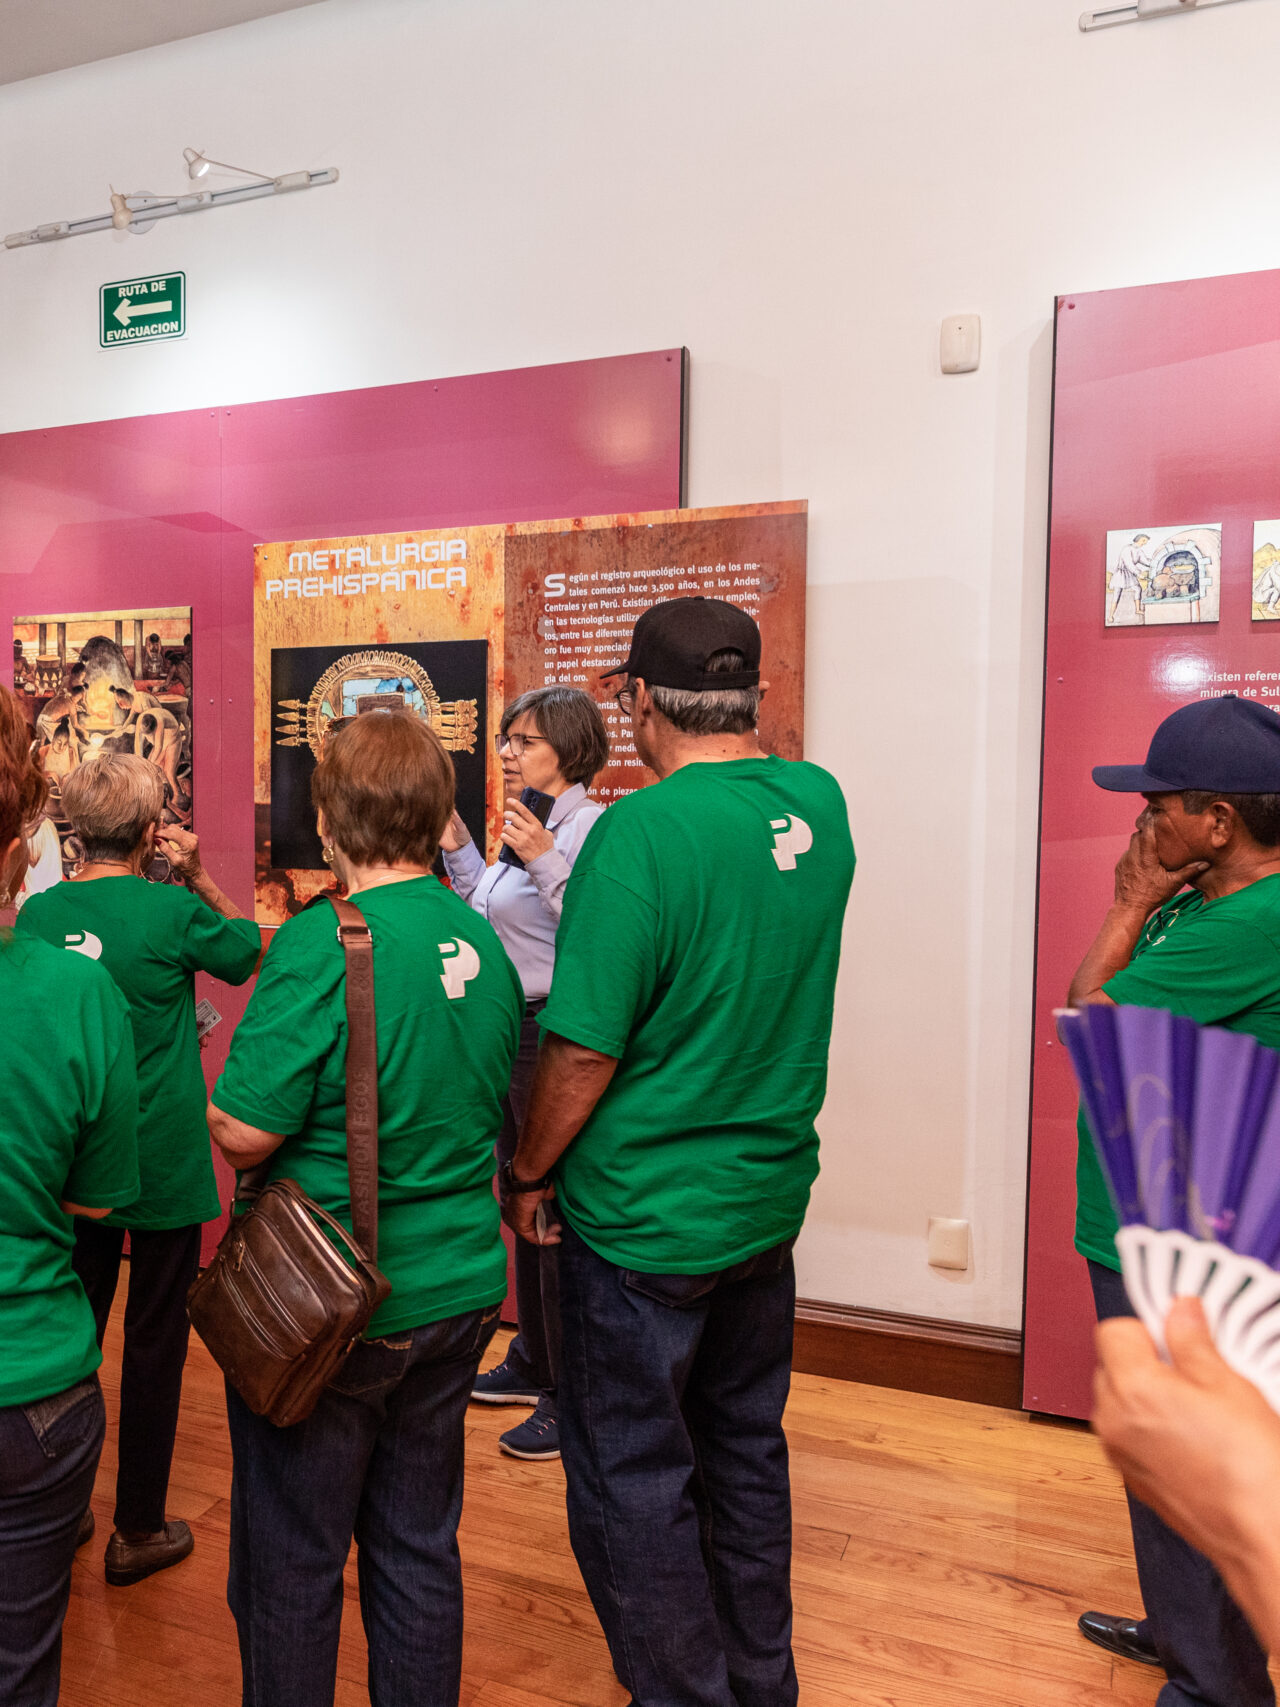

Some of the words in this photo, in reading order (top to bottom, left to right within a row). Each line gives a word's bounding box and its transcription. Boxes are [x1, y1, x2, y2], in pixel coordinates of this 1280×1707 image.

[118, 283, 148, 298] RUTA
[150, 280, 166, 293] DE
[106, 321, 179, 341] EVACUACION
[288, 539, 466, 572] METALURGIA
[591, 571, 598, 581] el
[600, 570, 631, 581] registro
[633, 565, 685, 579] arqueológico
[688, 564, 695, 574] el
[697, 565, 713, 574] uso
[715, 562, 726, 572] de
[728, 562, 741, 572] los
[744, 562, 760, 571] me-
[266, 566, 466, 600] PREHISPÁNICA
[569, 587, 587, 597] tales
[591, 584, 625, 595] comenzó
[629, 584, 648, 593] hace
[678, 580, 700, 590] años,
[704, 580, 714, 588] en
[718, 578, 730, 587] los
[734, 576, 760, 586] Andes
[544, 601, 579, 612] Centrales
[582, 603, 587, 612] y
[589, 602, 598, 610] en
[600, 599, 620, 609] Perú.
[622, 598, 653, 608] Existían
[726, 592, 760, 603] empleo,
[544, 619, 553, 627] en
[556, 617, 567, 625] las
[570, 614, 614, 625] tecnologías
[616, 613, 640, 622] utiliza
[544, 632, 558, 641] tos,
[561, 631, 580, 640] entre
[582, 630, 593, 638] las
[595, 628, 634, 638] diferentes
[544, 647, 557, 655] oro
[559, 645, 572, 654] fue
[575, 645, 591, 655] muy
[544, 661, 554, 669] un
[557, 659, 578, 670] papel
[581, 657, 621, 668] destacado
[558, 674, 571, 683] del
[1245, 670, 1280, 681] refere
[1243, 686, 1257, 697] de
[595, 701, 618, 709] entas
[607, 715, 618, 724] de
[624, 758, 645, 767] resin
[600, 787, 610, 795] de
